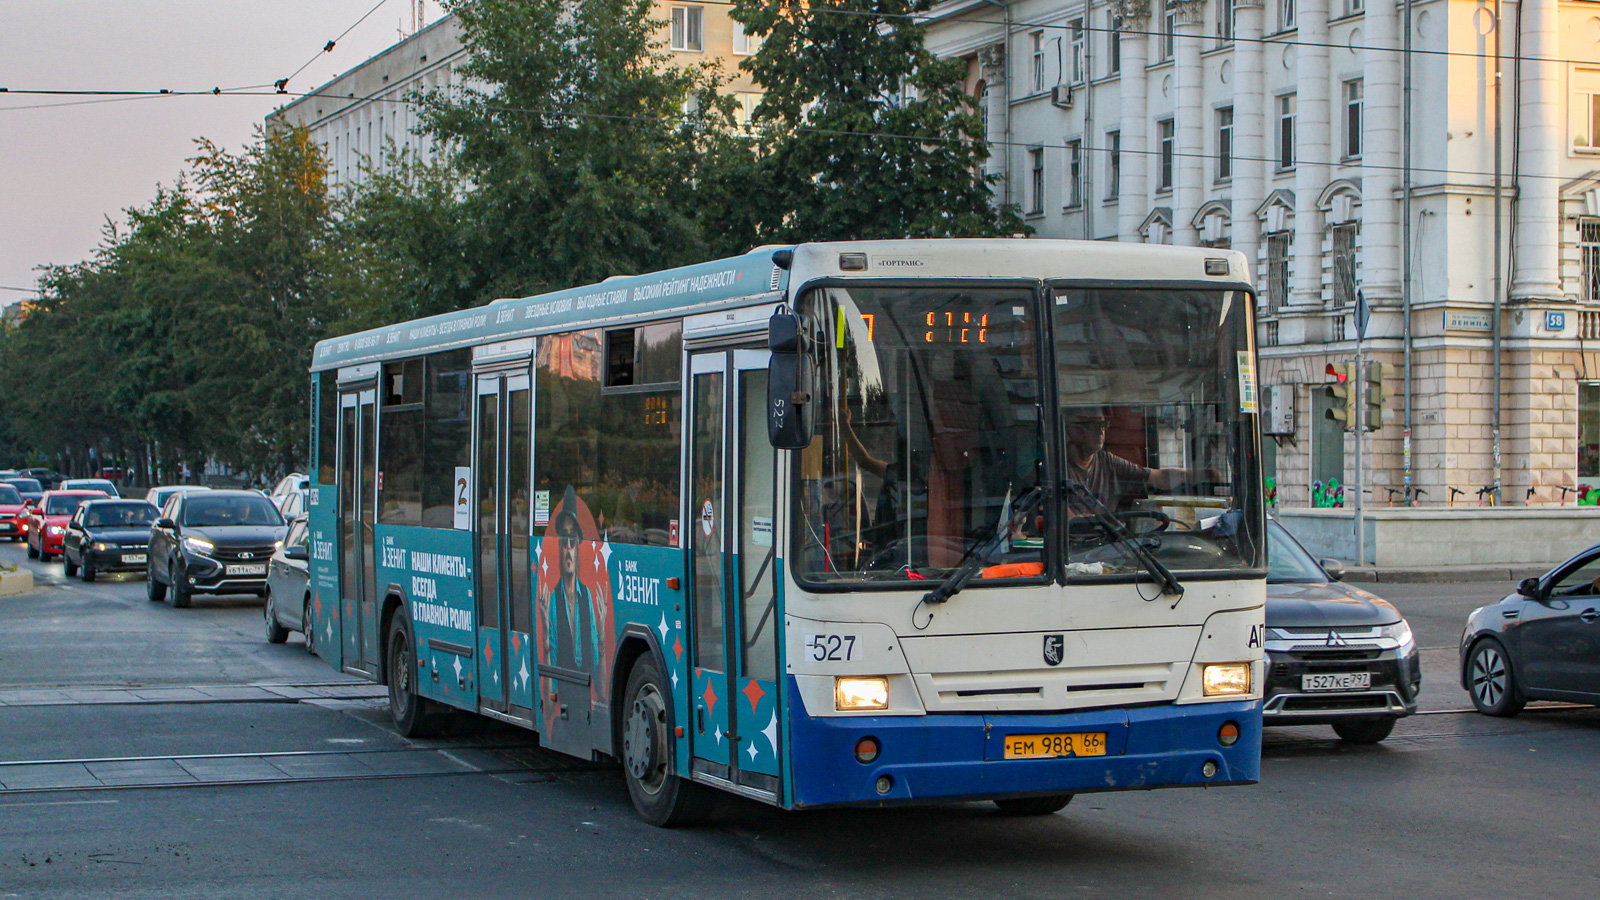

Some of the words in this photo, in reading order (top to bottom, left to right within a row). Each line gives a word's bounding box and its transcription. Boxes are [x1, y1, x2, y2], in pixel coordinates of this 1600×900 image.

[878, 259, 924, 268] «ГОРТРАНС»
[633, 282, 662, 302] ВЫСОКИЙ
[662, 277, 690, 298] РЕЙТИНГ
[690, 270, 736, 294] НАДЕЖНОСТИ
[525, 301, 549, 319] ЗВЕЗДНЫЕ
[549, 298, 573, 315] УСЛОВИЯ
[577, 292, 605, 311] ВЫГОДНЫЕ
[605, 289, 628, 306] СТАВКИ
[499, 308, 515, 324] ЗЕНИТ
[1451, 319, 1489, 327] ЛЕНИНА
[1550, 316, 1562, 326] 58
[457, 477, 467, 506] 2
[317, 542, 333, 561] ЗЕНИТ
[386, 548, 406, 570] ЗЕНИТ
[411, 551, 431, 574] НАШИ
[432, 553, 466, 578] КЛИЕНТЫ
[625, 560, 638, 573] БАНК
[412, 576, 437, 603] ВСЕГДА
[625, 574, 660, 606] ЗЕНИТ
[413, 601, 418, 621] В
[419, 600, 449, 627] ГЛАВНОЙ
[450, 607, 472, 632] РОЛИ!
[813, 634, 856, 661] 527
[1306, 675, 1350, 688] Т527КЕ
[1350, 674, 1368, 684] 797
[1014, 742, 1034, 755] ЕМ
[1042, 736, 1073, 754] 988
[1083, 734, 1099, 747] 66
